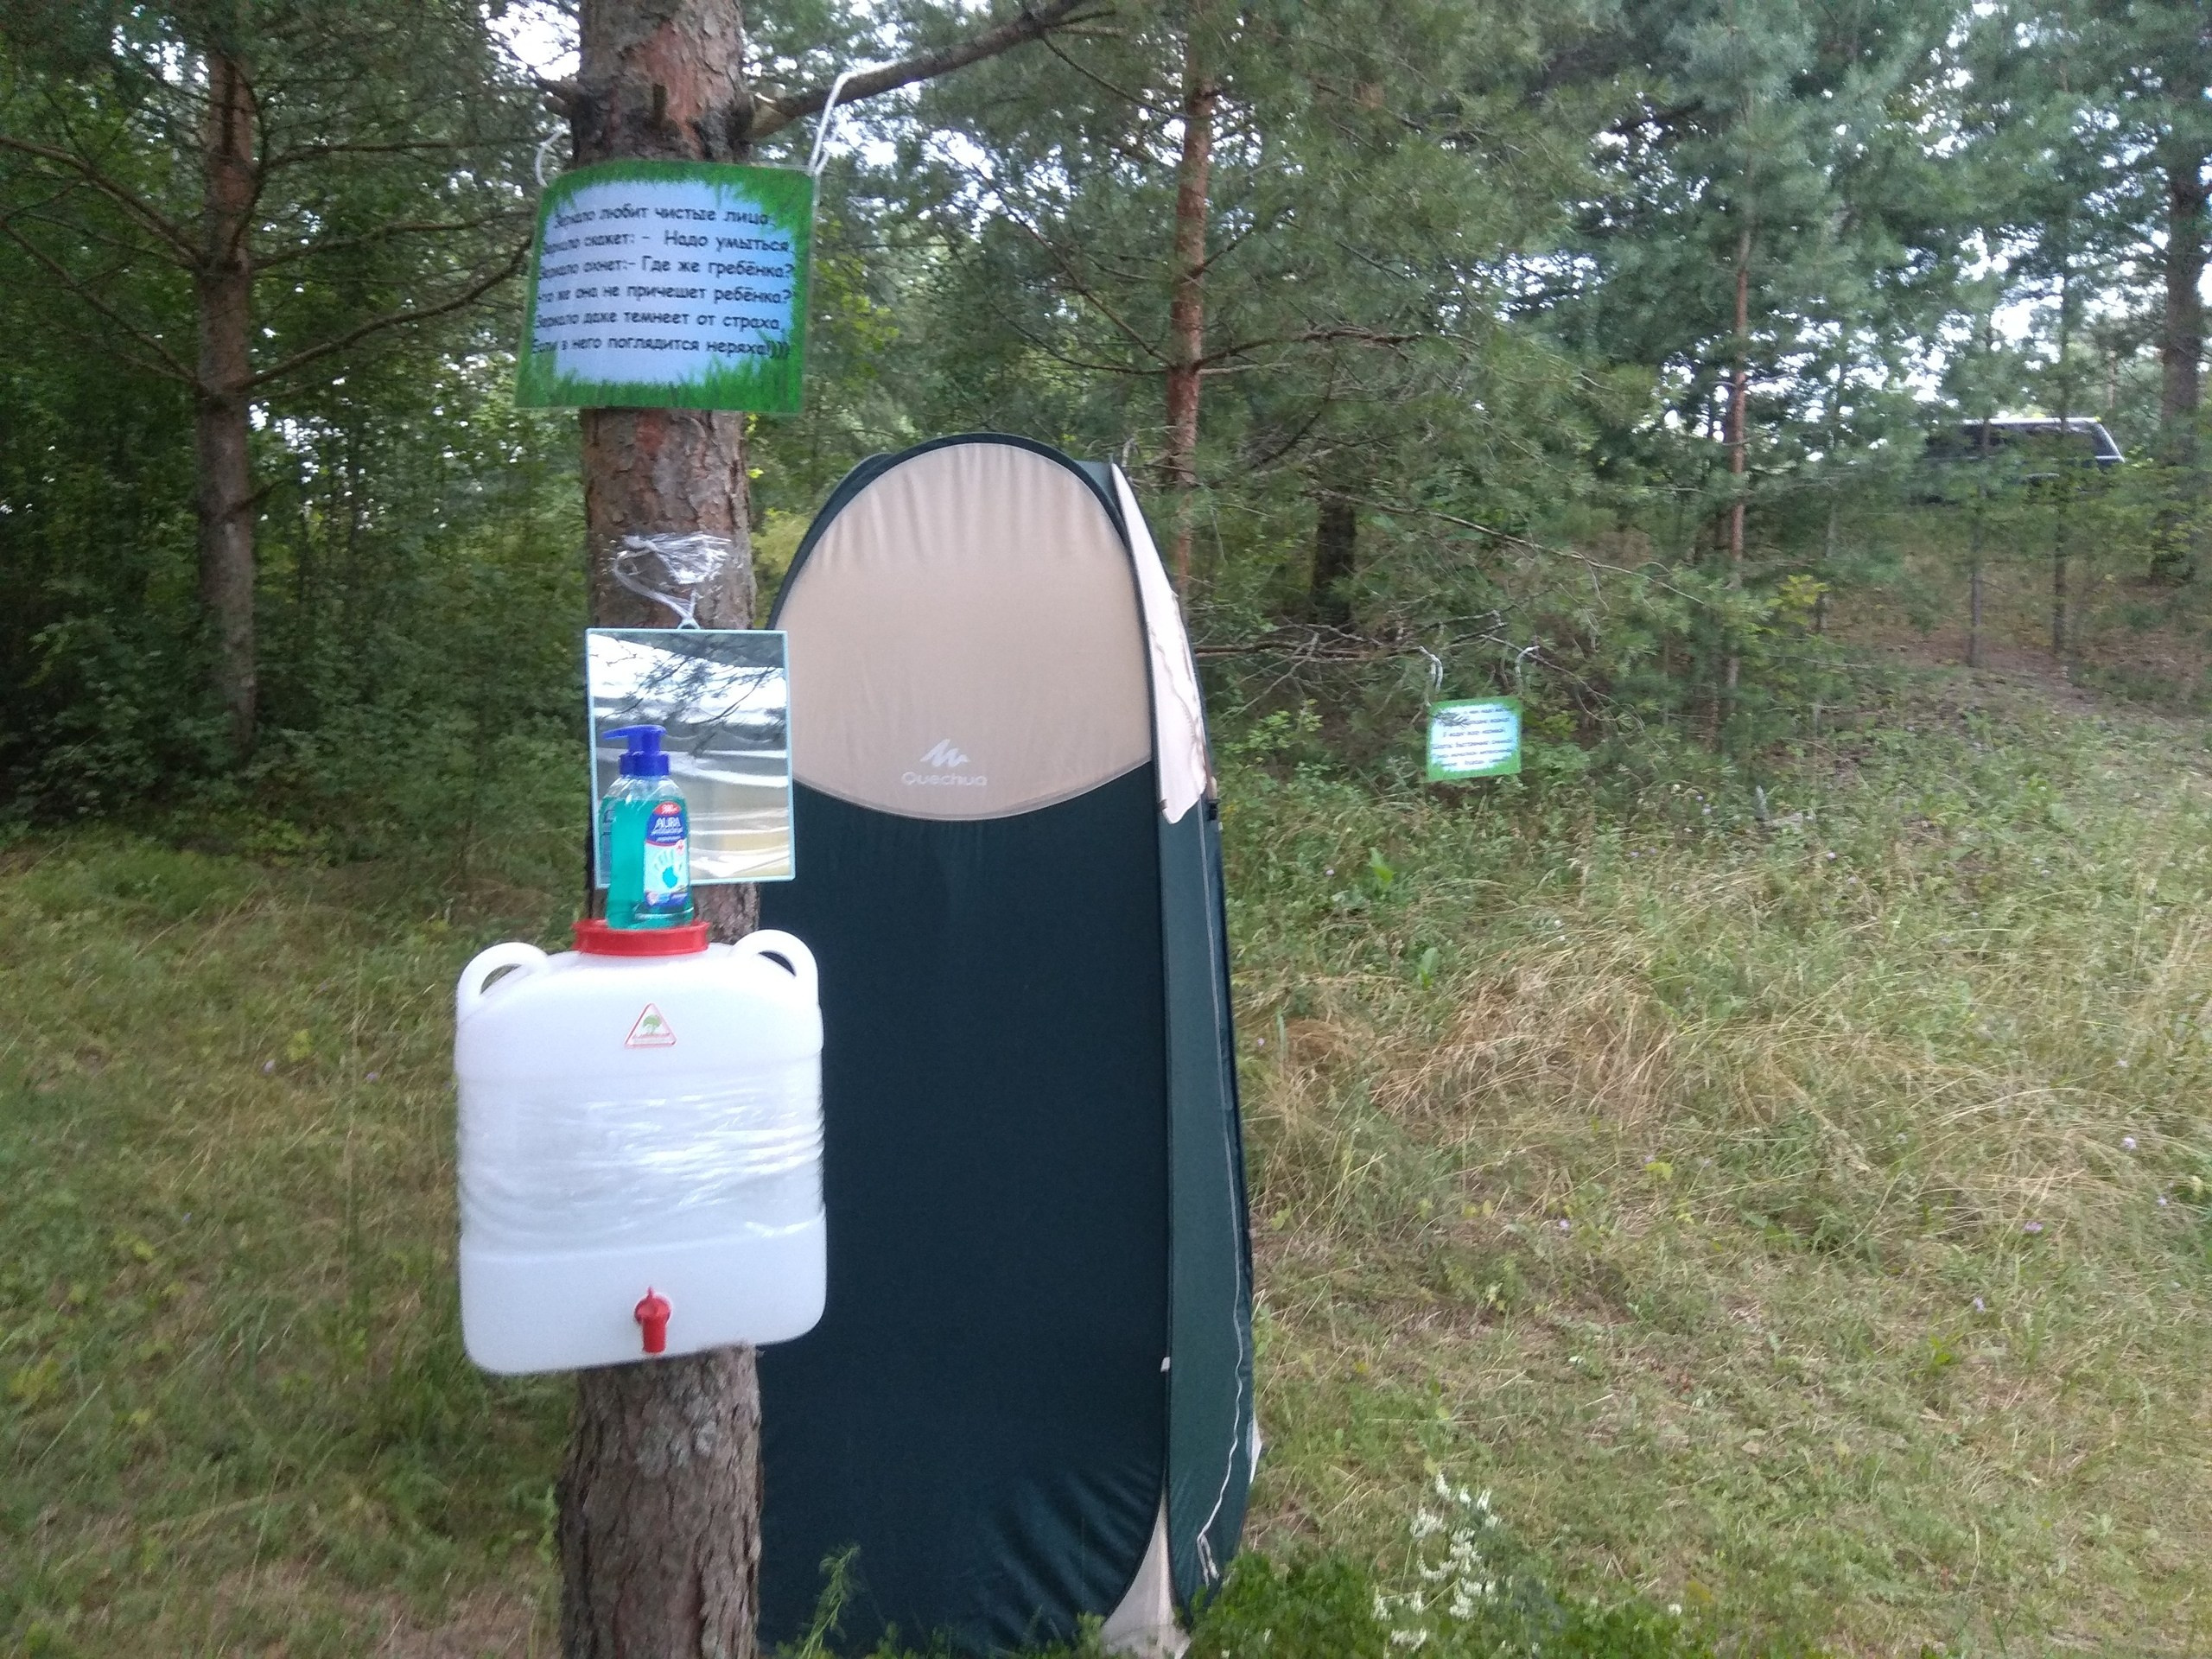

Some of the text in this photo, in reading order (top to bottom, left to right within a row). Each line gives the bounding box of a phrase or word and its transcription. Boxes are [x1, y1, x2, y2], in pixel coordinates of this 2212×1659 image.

[600, 203, 649, 219] любит
[654, 208, 717, 221] чистые
[584, 233, 635, 247] скажет:
[664, 229, 709, 248] Надо
[641, 255, 671, 273] Где
[677, 261, 701, 273] же
[708, 260, 795, 278] гребёнка?
[575, 287, 599, 298] она
[602, 286, 620, 297] не
[626, 286, 708, 302] причешет
[714, 286, 793, 304] ребёнка?
[582, 312, 618, 324] даже
[624, 312, 690, 325] темнеет
[696, 315, 716, 327] от
[570, 338, 602, 350] него
[607, 338, 700, 352] поглядится
[901, 772, 988, 786] Quechua
[654, 817, 681, 829] AURA
